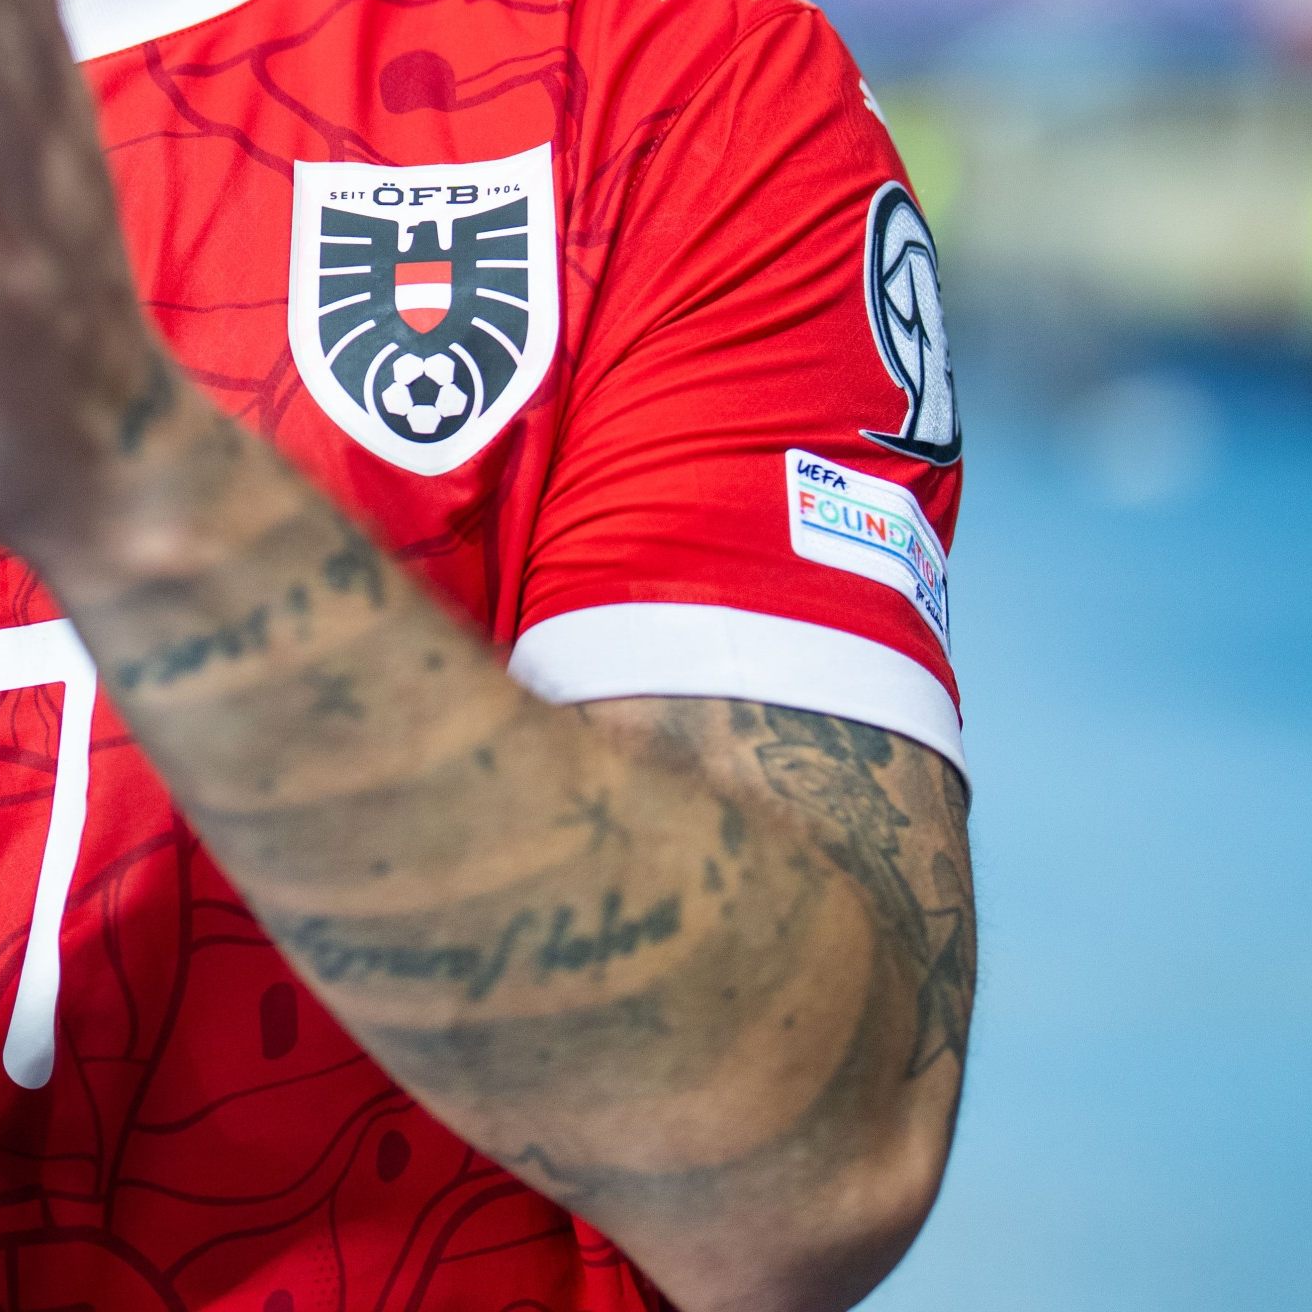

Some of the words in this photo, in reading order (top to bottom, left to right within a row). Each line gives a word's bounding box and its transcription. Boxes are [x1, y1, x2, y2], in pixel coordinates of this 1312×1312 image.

[329, 191, 366, 200] SEIT
[372, 182, 479, 206] ÖFB
[487, 183, 521, 196] 1904
[797, 459, 847, 491] UEFA
[799, 490, 944, 603] FOUNDATION
